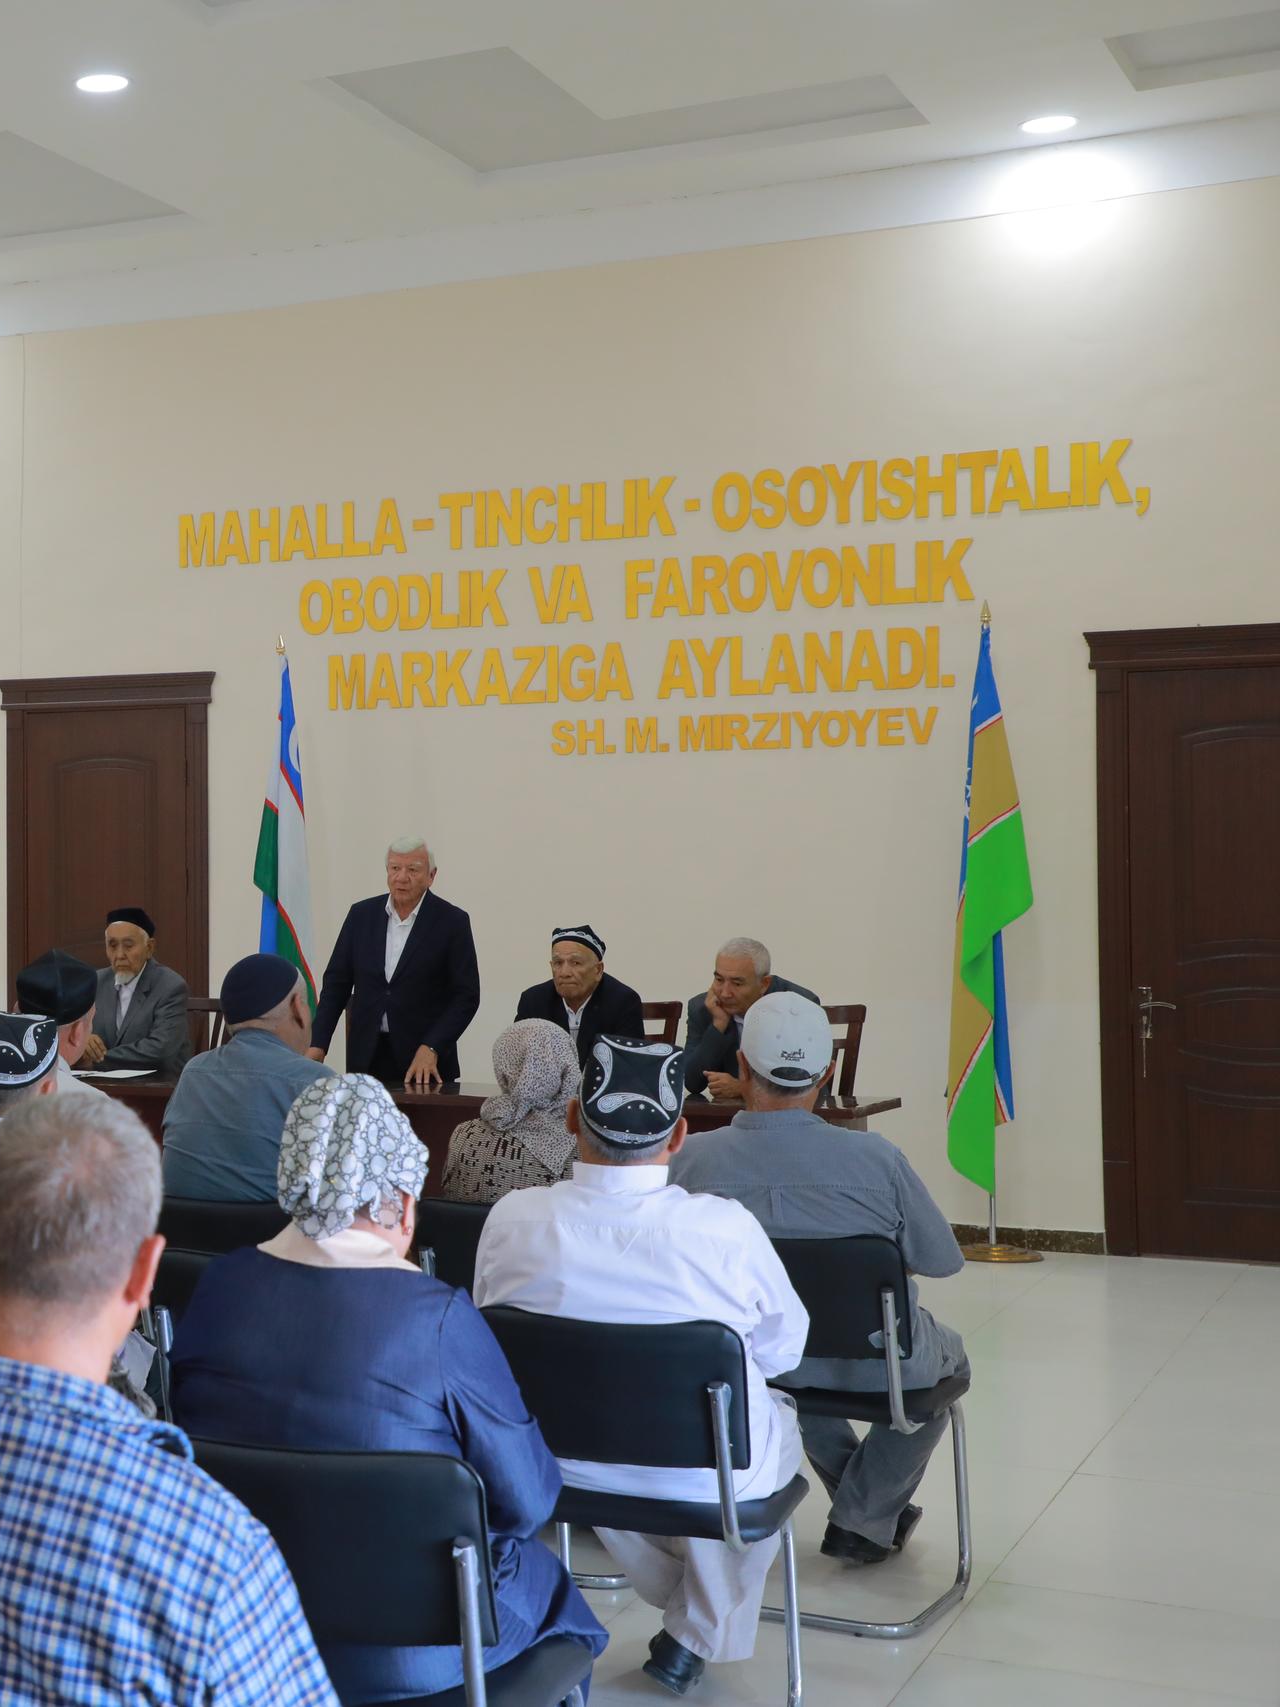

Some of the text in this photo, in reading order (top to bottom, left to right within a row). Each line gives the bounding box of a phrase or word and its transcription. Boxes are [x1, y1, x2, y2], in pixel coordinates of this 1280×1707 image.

[712, 438, 1151, 533] OSOYISHTALIK,
[299, 537, 975, 636] OBODLIK VA FAROVONLIK
[328, 625, 956, 711] MARKAZIGA AYLANADI.
[551, 705, 939, 756] SH. M. MIRZIYOYEV
